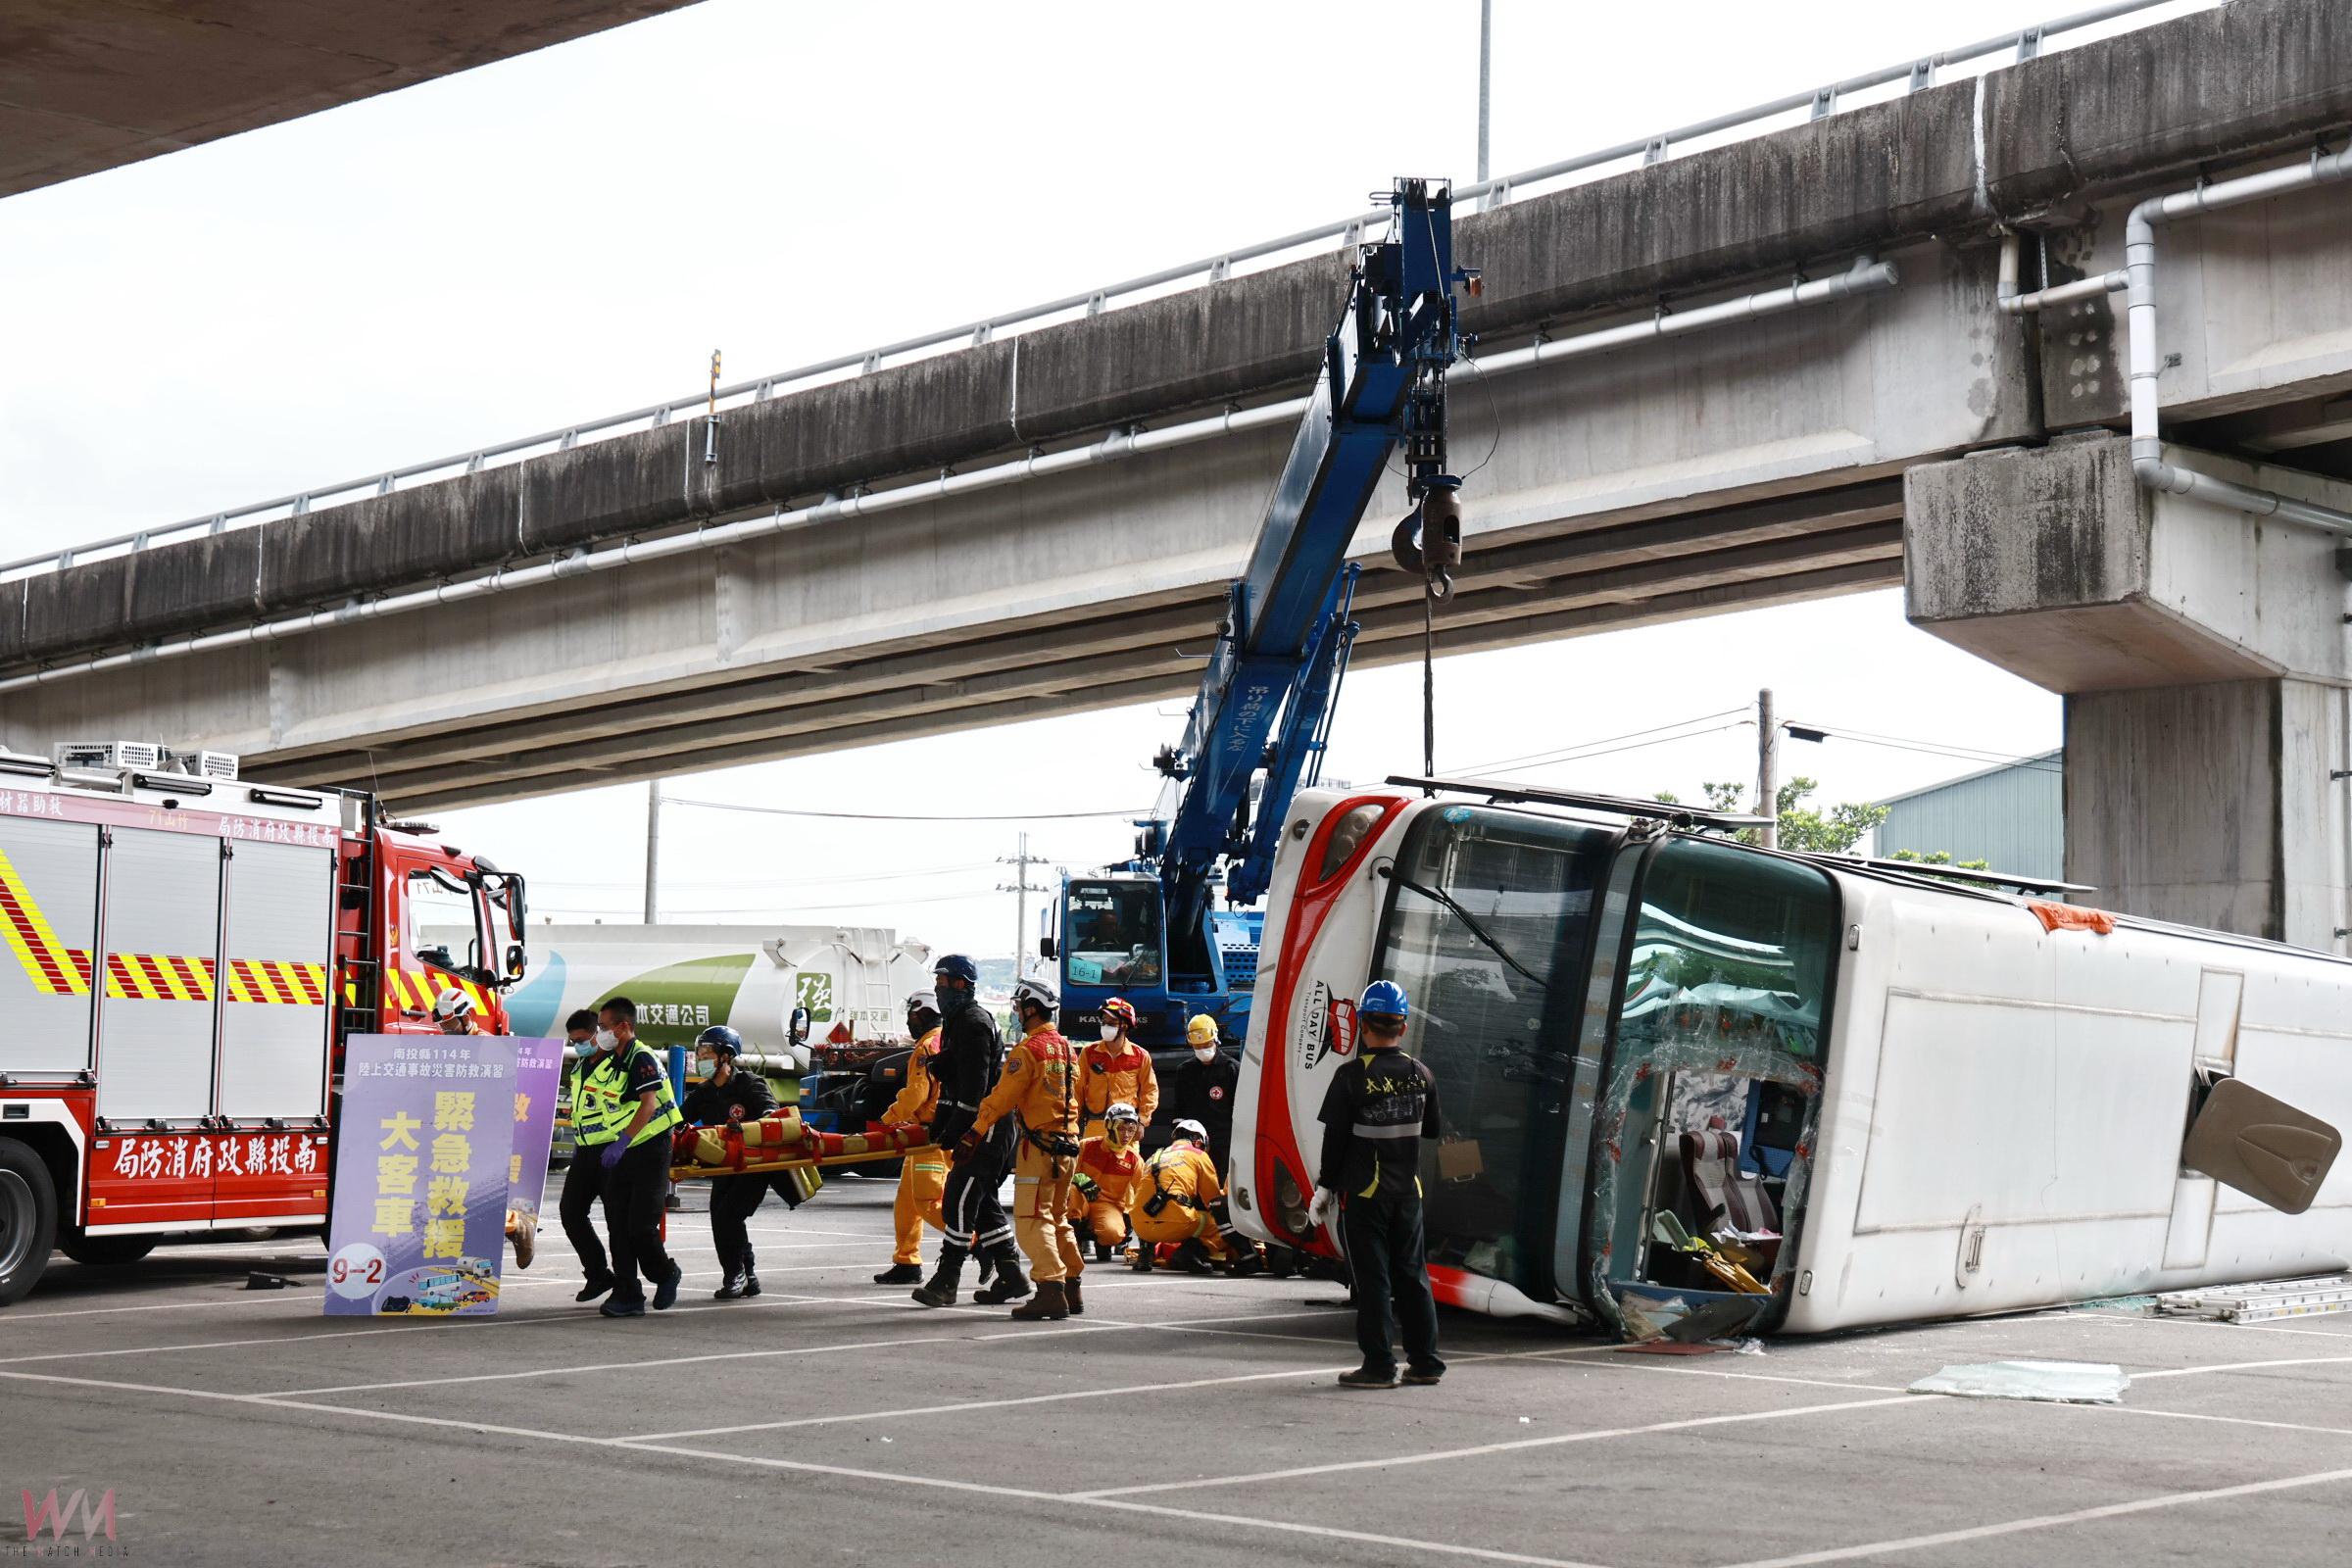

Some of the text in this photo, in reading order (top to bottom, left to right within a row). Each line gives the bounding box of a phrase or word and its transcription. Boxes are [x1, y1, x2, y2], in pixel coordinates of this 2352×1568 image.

[1072, 965, 1097, 979] 16-1
[1304, 980, 1324, 1070] ALL DAY BUS
[359, 1062, 504, 1078] 陸上交通事故災害防救演習
[371, 1110, 422, 1238] 大客車
[423, 1091, 475, 1258] 緊急救援
[332, 1258, 382, 1284] 9-2
